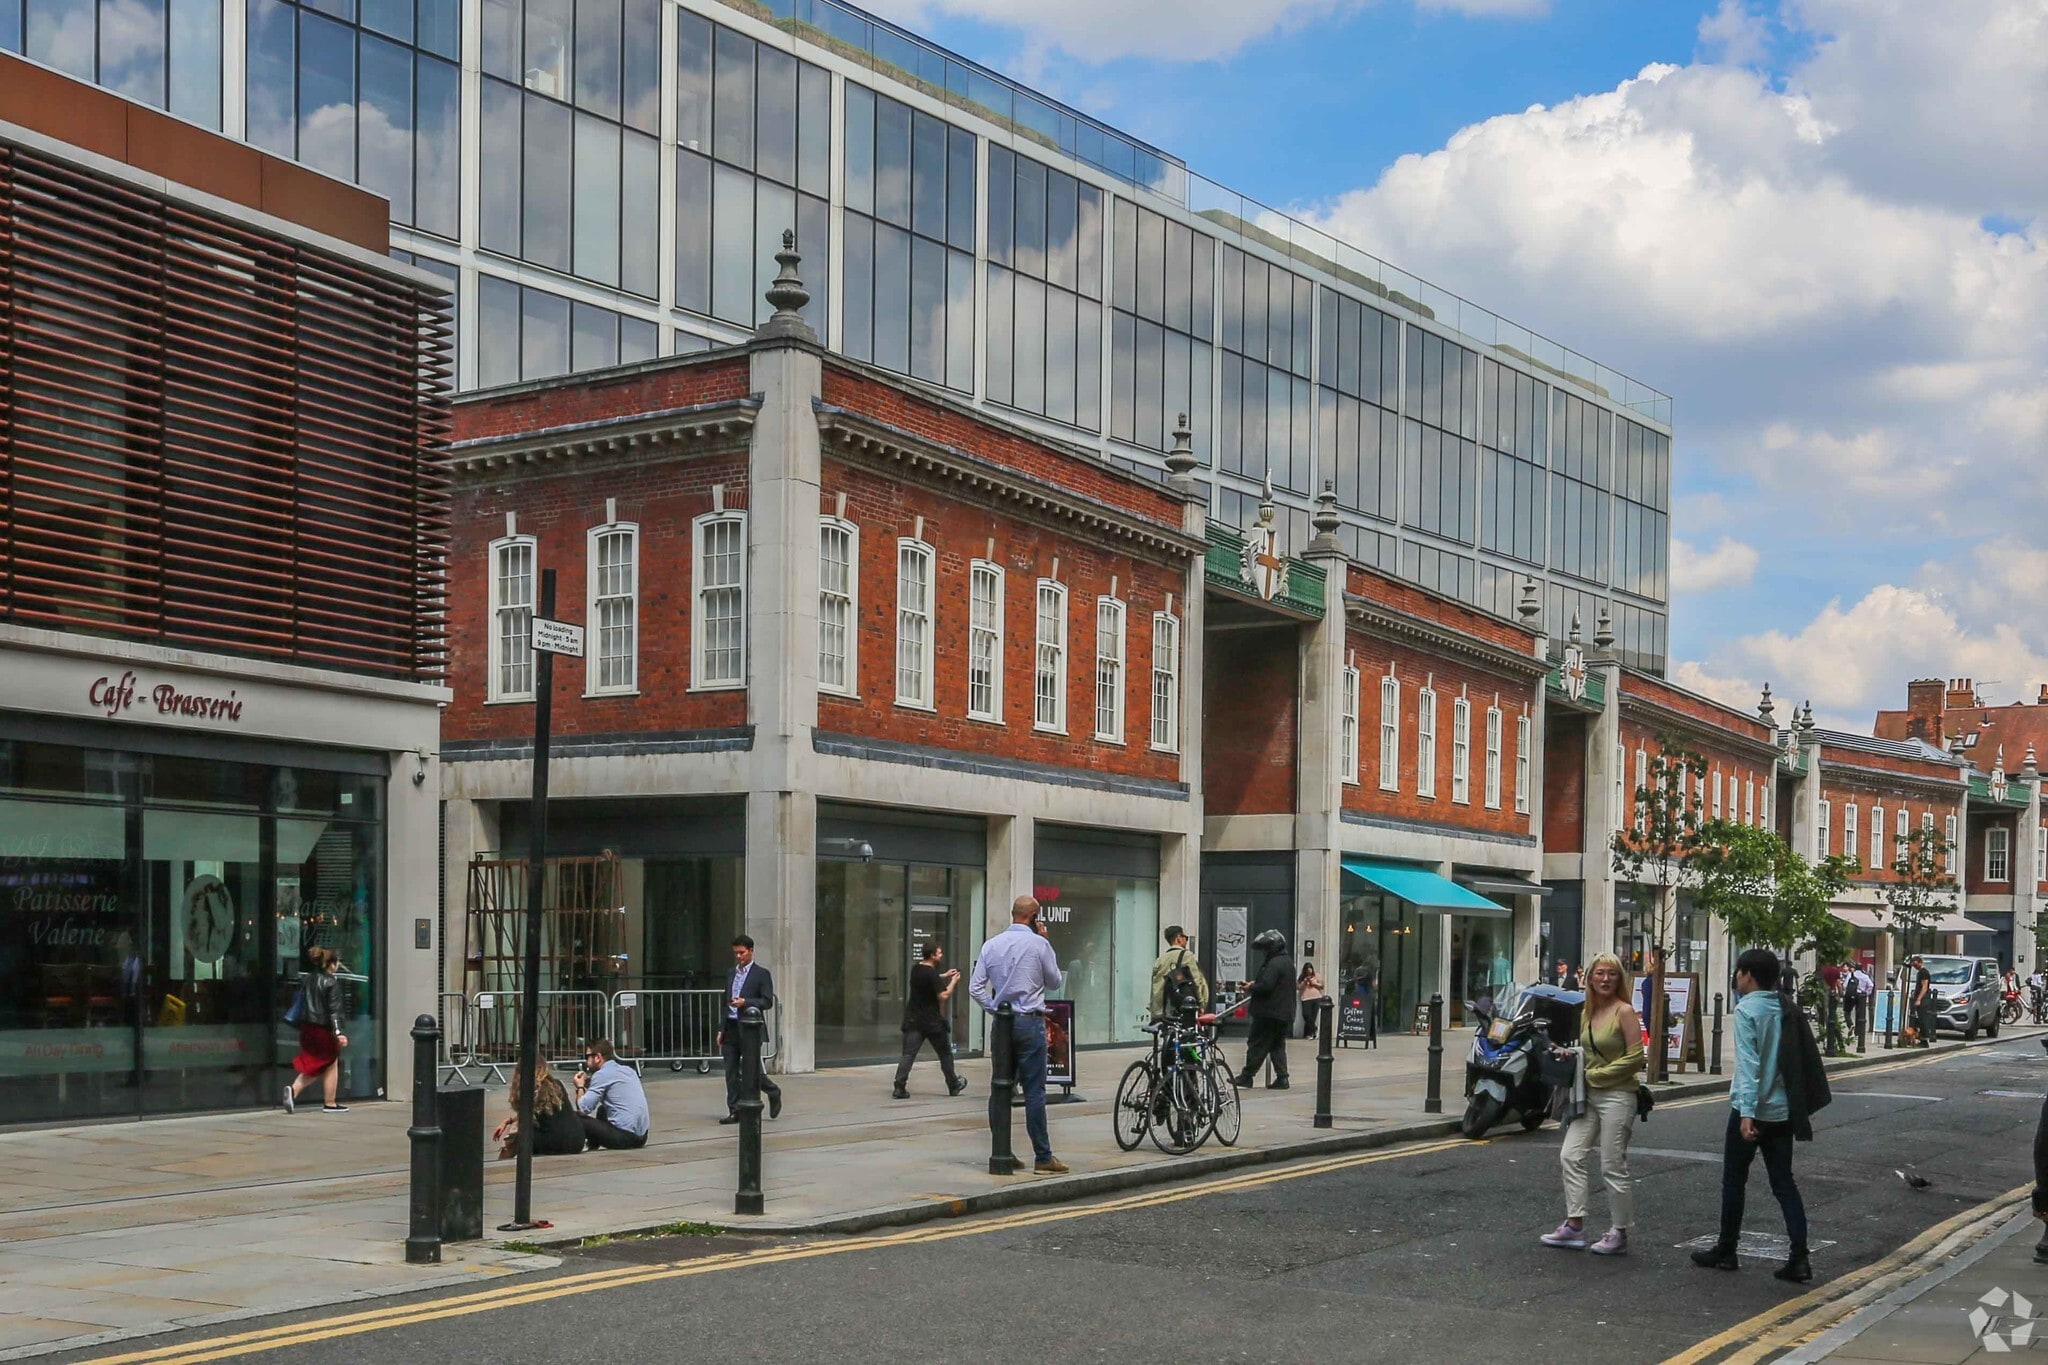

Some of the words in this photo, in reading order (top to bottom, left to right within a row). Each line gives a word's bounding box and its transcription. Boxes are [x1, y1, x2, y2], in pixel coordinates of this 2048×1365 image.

[537, 630, 562, 641] Midnight
[554, 642, 579, 653] Midnight
[89, 671, 137, 717] Café
[152, 683, 244, 721] Brasserie
[13, 886, 118, 912] Patisserie
[1047, 906, 1071, 922] UNIT
[28, 916, 106, 945] Valerie
[1343, 1007, 1363, 1016] Coffee
